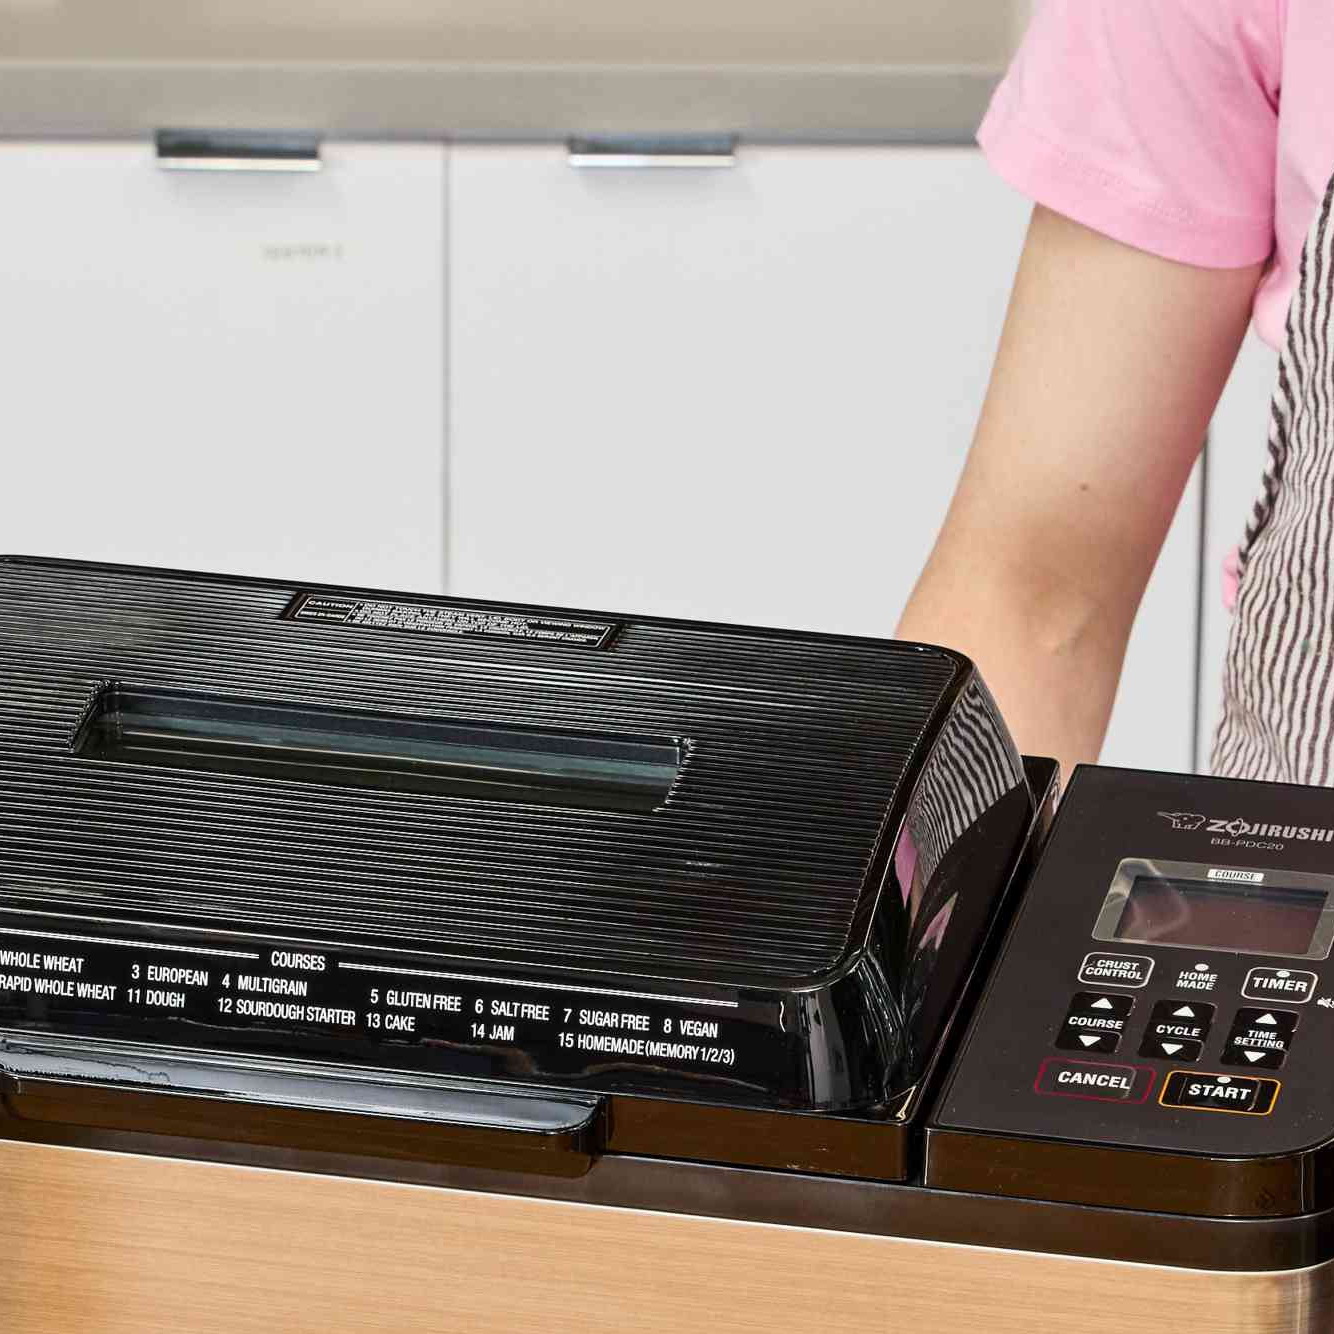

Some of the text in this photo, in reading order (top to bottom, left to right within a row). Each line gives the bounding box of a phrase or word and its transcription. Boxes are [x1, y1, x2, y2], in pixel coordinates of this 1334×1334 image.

[1206, 818, 1334, 842] ZOJIRUSHI
[1210, 838, 1284, 851] BB-PDC20
[1214, 870, 1257, 880] COURSE
[0, 950, 41, 969] WHOLE
[44, 955, 84, 973] WHEAT
[271, 951, 326, 971] COURSES
[1097, 959, 1139, 971] CRUST
[131, 964, 209, 986] 3 EUROPEAN
[1085, 967, 1144, 981] CONTROL
[1179, 971, 1217, 982] HOME
[34, 978, 75, 997] WHOLE
[77, 982, 117, 1001] WHEAT
[222, 974, 308, 997] 4 MULTIGRAIN
[1176, 980, 1215, 991] MADE
[1252, 977, 1308, 993] TIMER
[127, 988, 185, 1009] 11 DOUGH
[370, 989, 462, 1012] 5 GLUTEN FREE
[217, 999, 356, 1026] 12 SOURDOUGH STARTER
[474, 999, 550, 1021] 6 SALT FREE
[563, 1008, 650, 1031] 7 SUGAR FREE
[366, 1012, 416, 1032] 13 CAKE
[663, 1018, 718, 1038] 8 VEGAN
[1068, 1016, 1123, 1030] COURSE
[1156, 1025, 1201, 1037] CYCLE
[471, 1023, 515, 1041] 14 JAM
[1248, 1030, 1277, 1040] TIME
[558, 1032, 573, 1048] 15
[701, 1047, 735, 1066] 1/2/3)
[1234, 1036, 1284, 1049] SETTING
[1058, 1071, 1131, 1090] CANCEL
[1189, 1084, 1251, 1100] START
